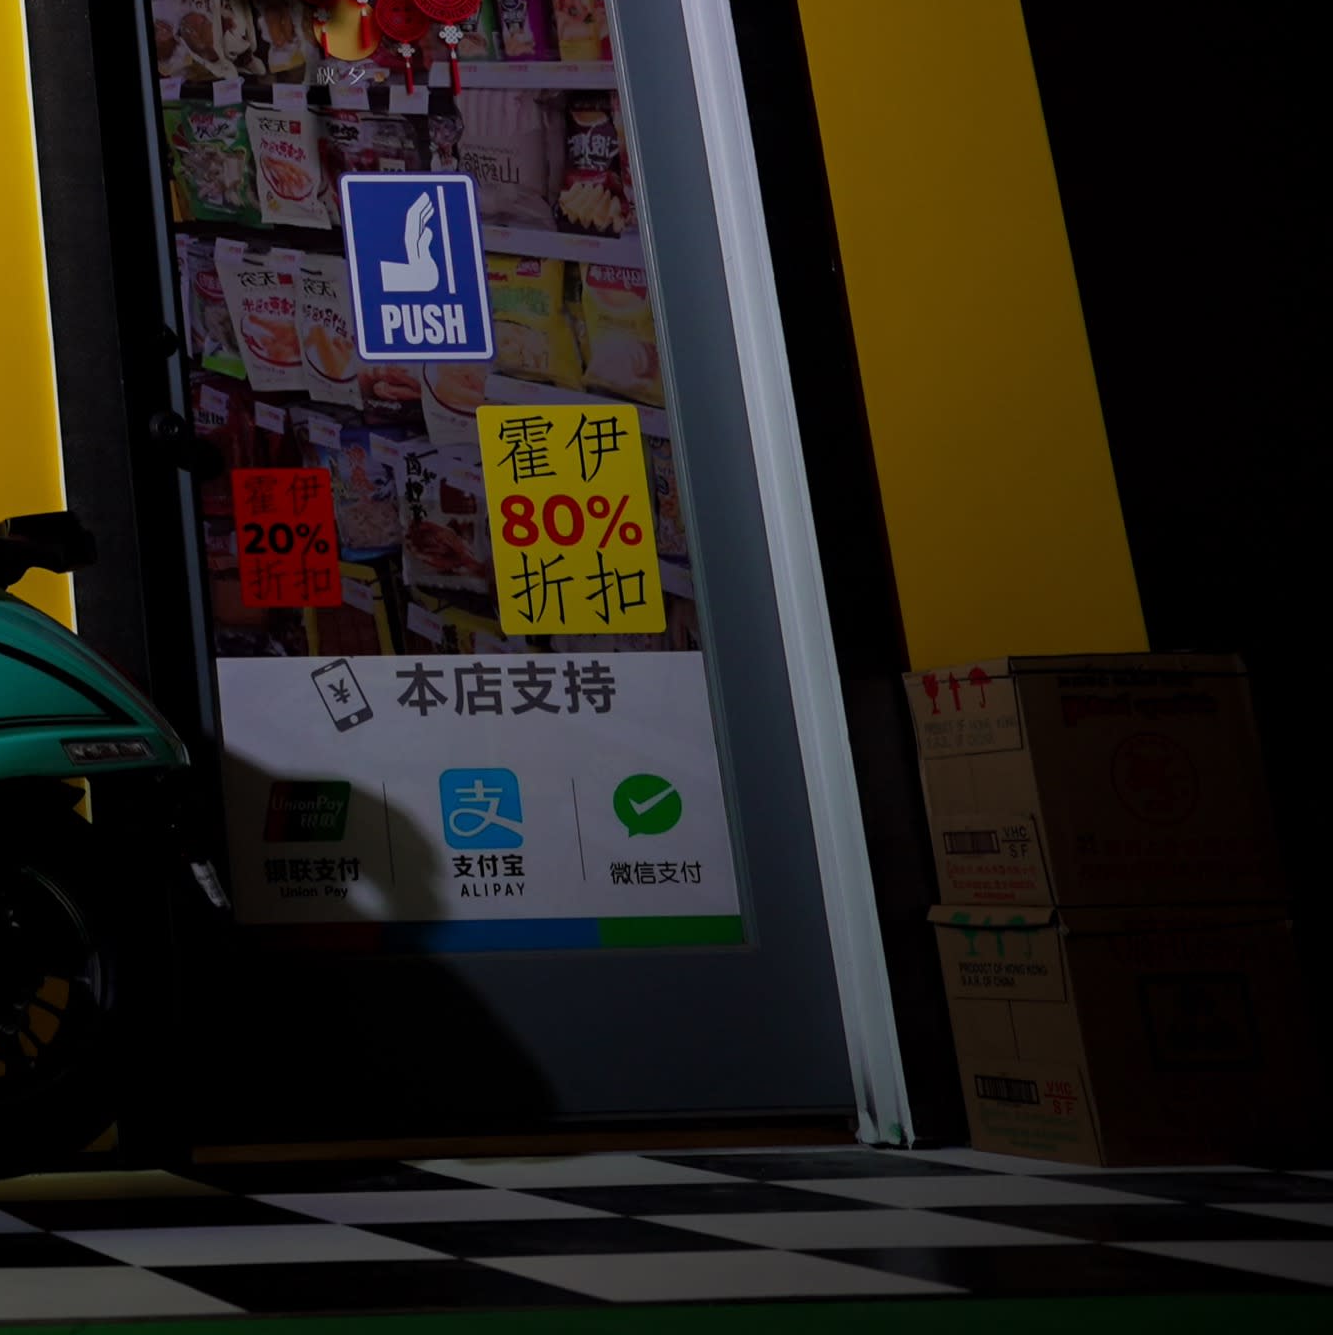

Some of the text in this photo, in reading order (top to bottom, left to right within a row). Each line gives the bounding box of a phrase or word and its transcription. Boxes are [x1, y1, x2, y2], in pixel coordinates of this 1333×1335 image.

[380, 304, 467, 346] PUSH
[498, 412, 629, 483] 霍伊
[243, 522, 330, 555] 20%
[500, 495, 643, 549] 80%
[511, 550, 647, 625] 折扣
[396, 661, 617, 716] 本店支持
[453, 855, 525, 879] 支付宝
[610, 861, 702, 885] 微信支付
[460, 882, 526, 897] ALIPAY
